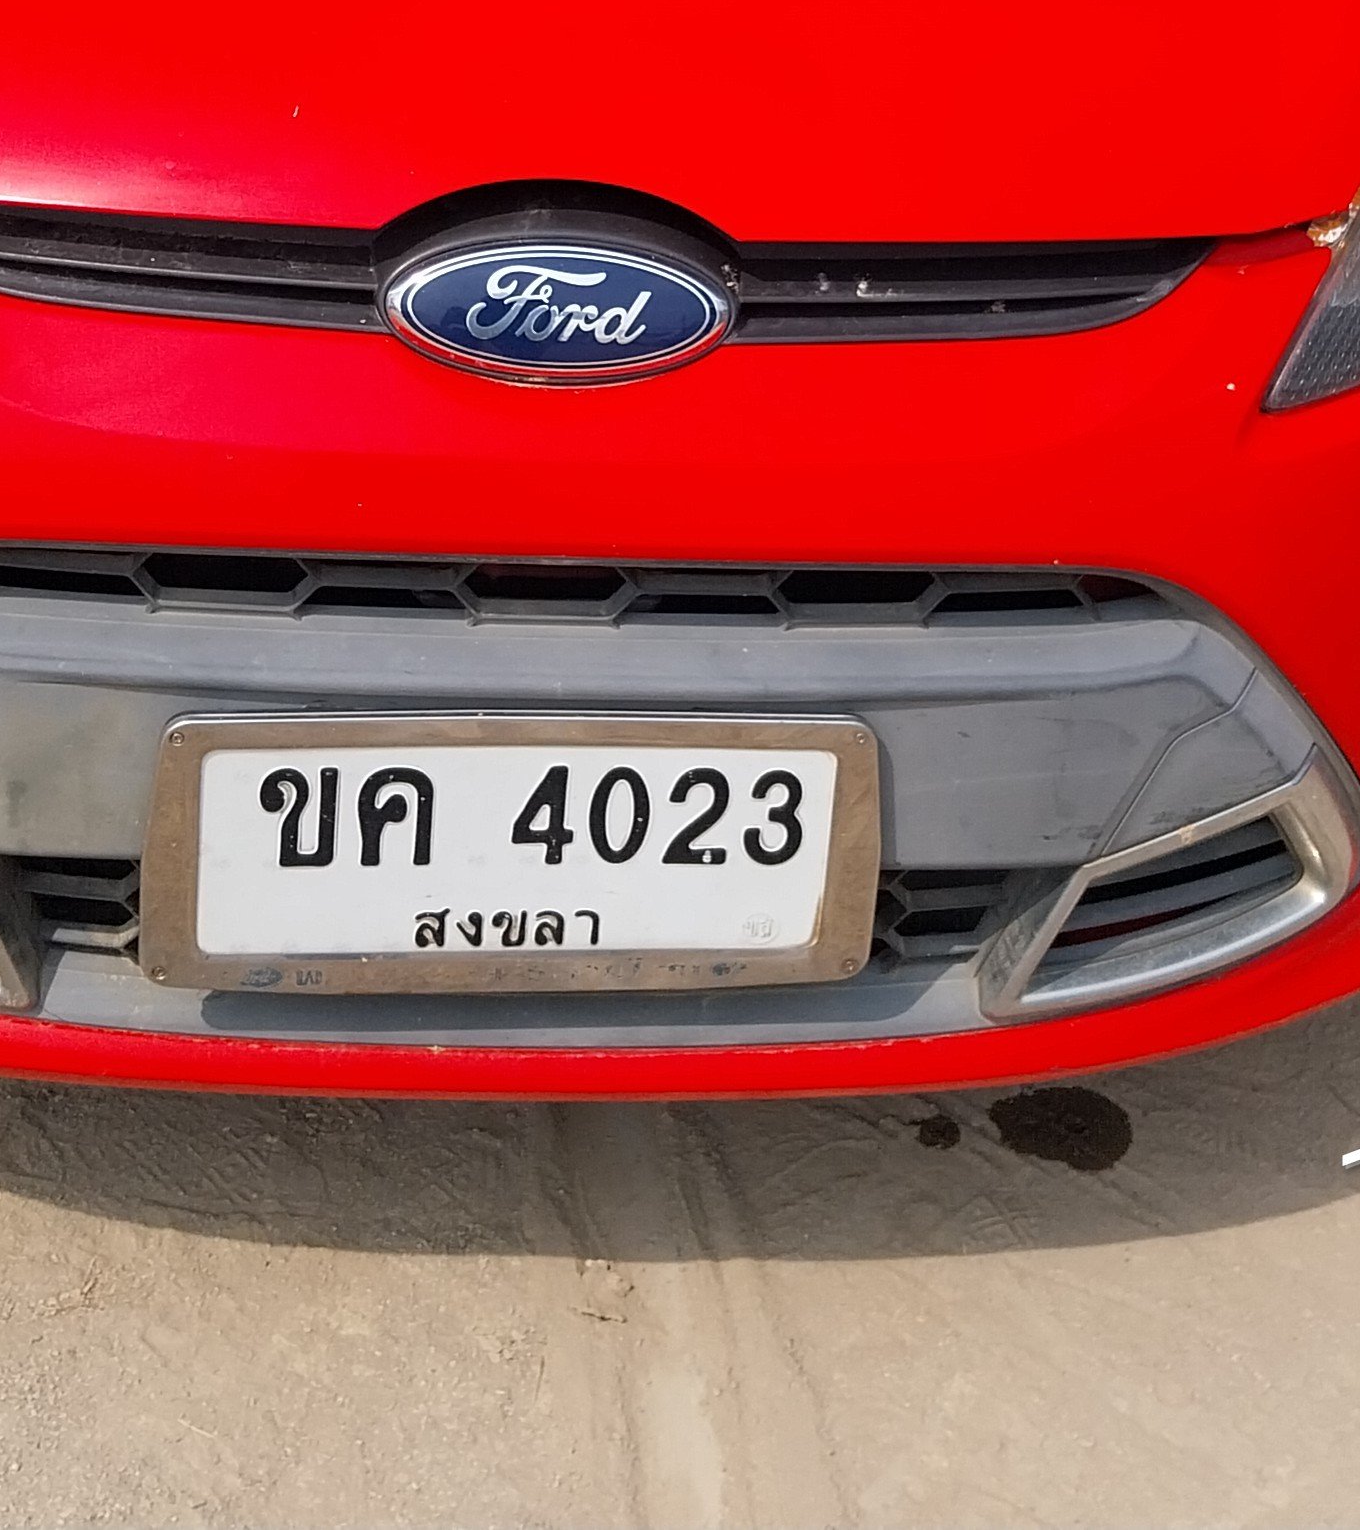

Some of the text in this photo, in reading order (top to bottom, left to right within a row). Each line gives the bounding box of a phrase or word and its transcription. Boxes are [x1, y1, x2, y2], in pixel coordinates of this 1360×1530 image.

[466, 265, 652, 345] Ford
[259, 766, 803, 867] ขค 4023
[414, 908, 601, 948] สงขลา
